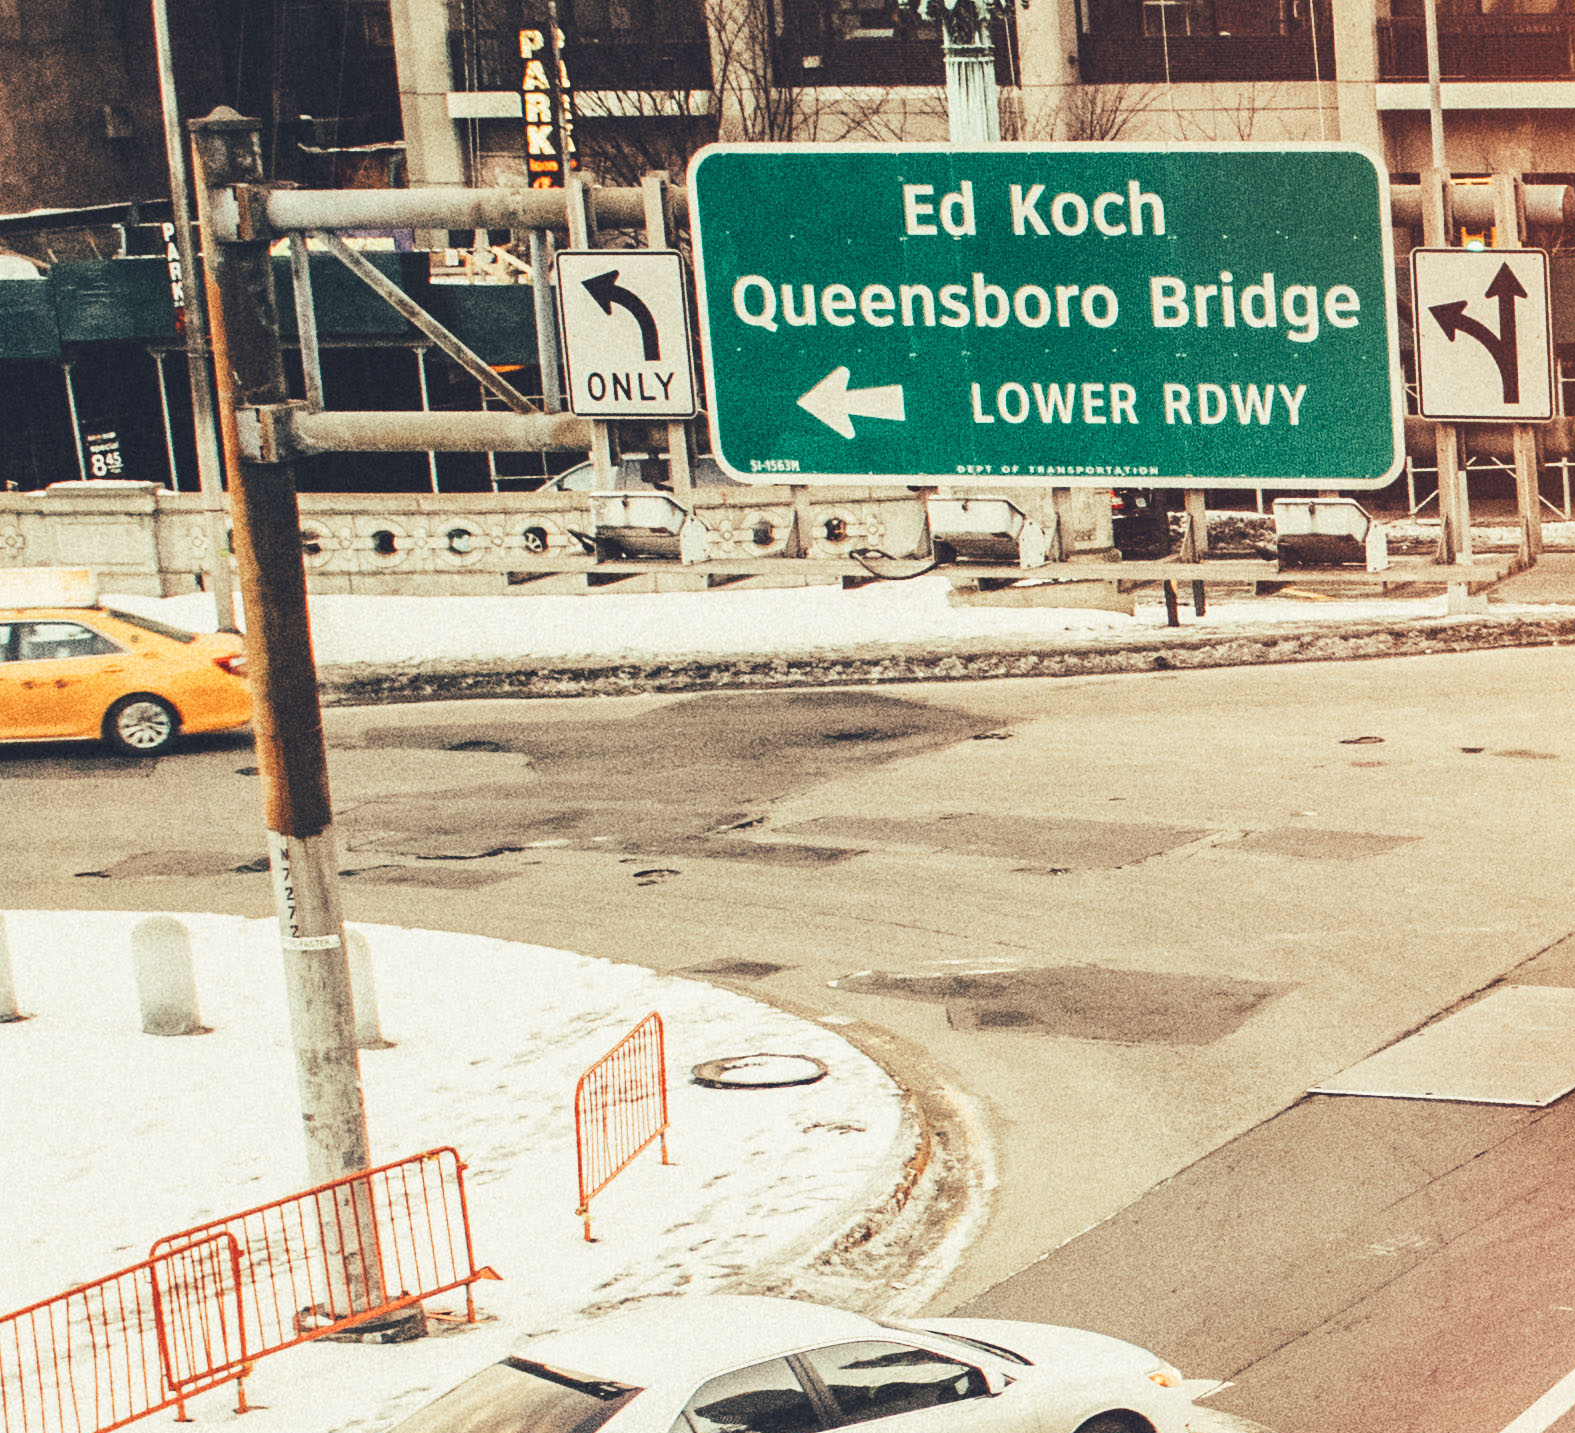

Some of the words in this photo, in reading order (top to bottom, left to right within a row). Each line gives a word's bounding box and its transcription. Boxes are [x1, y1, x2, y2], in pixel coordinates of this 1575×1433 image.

[519, 29, 557, 155] PARK
[904, 182, 975, 235] Ed
[1012, 180, 1167, 235] Koch
[733, 274, 1119, 332] Queensboro
[1151, 271, 1360, 343] Bridge
[588, 372, 675, 402] ONLY
[970, 382, 1138, 425] LOWER
[1165, 384, 1306, 426] RDWY
[957, 465, 994, 474] DEPT
[1002, 465, 1020, 474] OF
[1029, 465, 1160, 475] TRANSPORTATION
